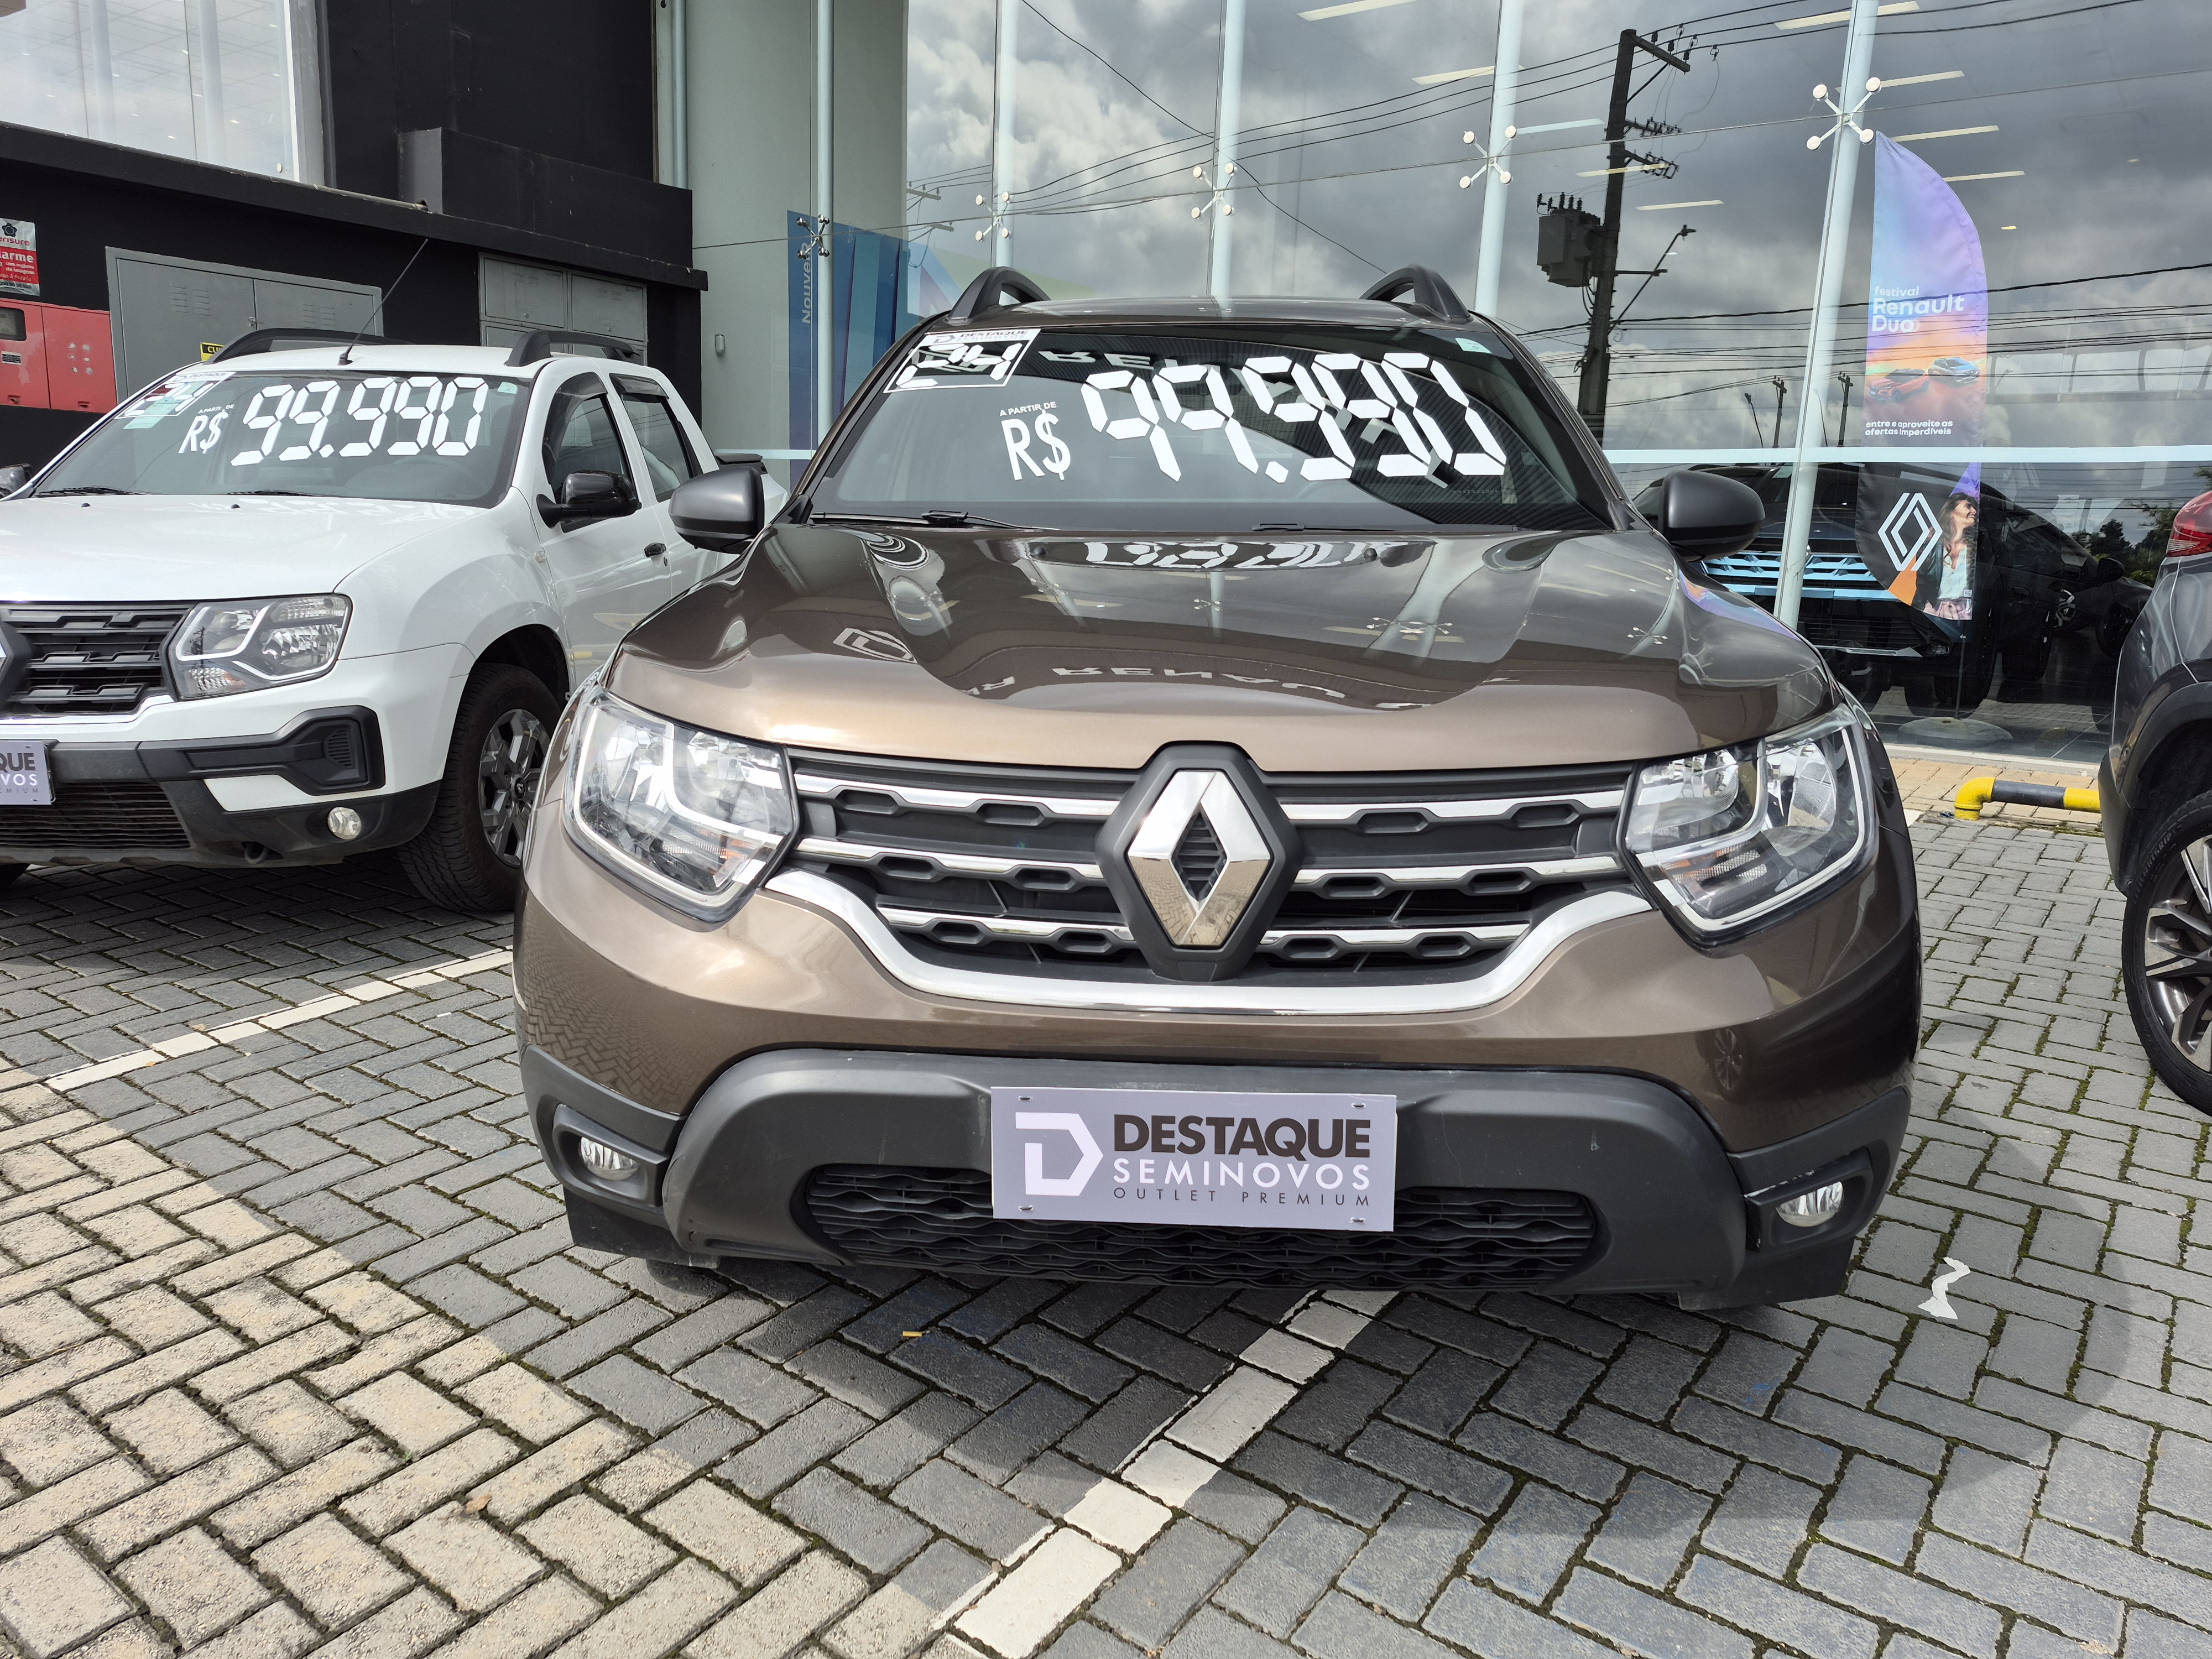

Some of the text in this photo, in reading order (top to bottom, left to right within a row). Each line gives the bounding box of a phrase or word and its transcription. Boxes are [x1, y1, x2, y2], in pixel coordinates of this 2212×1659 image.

[1874, 286, 1919, 296] festival
[1873, 294, 1964, 315] Renault
[1872, 315, 1920, 332] Duo
[1001, 352, 1506, 483] R$ 99.990
[1008, 404, 1042, 415] PARTIR
[1043, 401, 1057, 410] DE
[178, 376, 489, 466] R$ 99.990
[1898, 420, 1940, 429] aproveite
[1899, 427, 1952, 437] imperdíveis
[1114, 1114, 1370, 1161] DESTAQUE
[1113, 1158, 1370, 1191] SEMINOVOS
[1114, 1187, 1369, 1207] OUTLET PREMIUM
